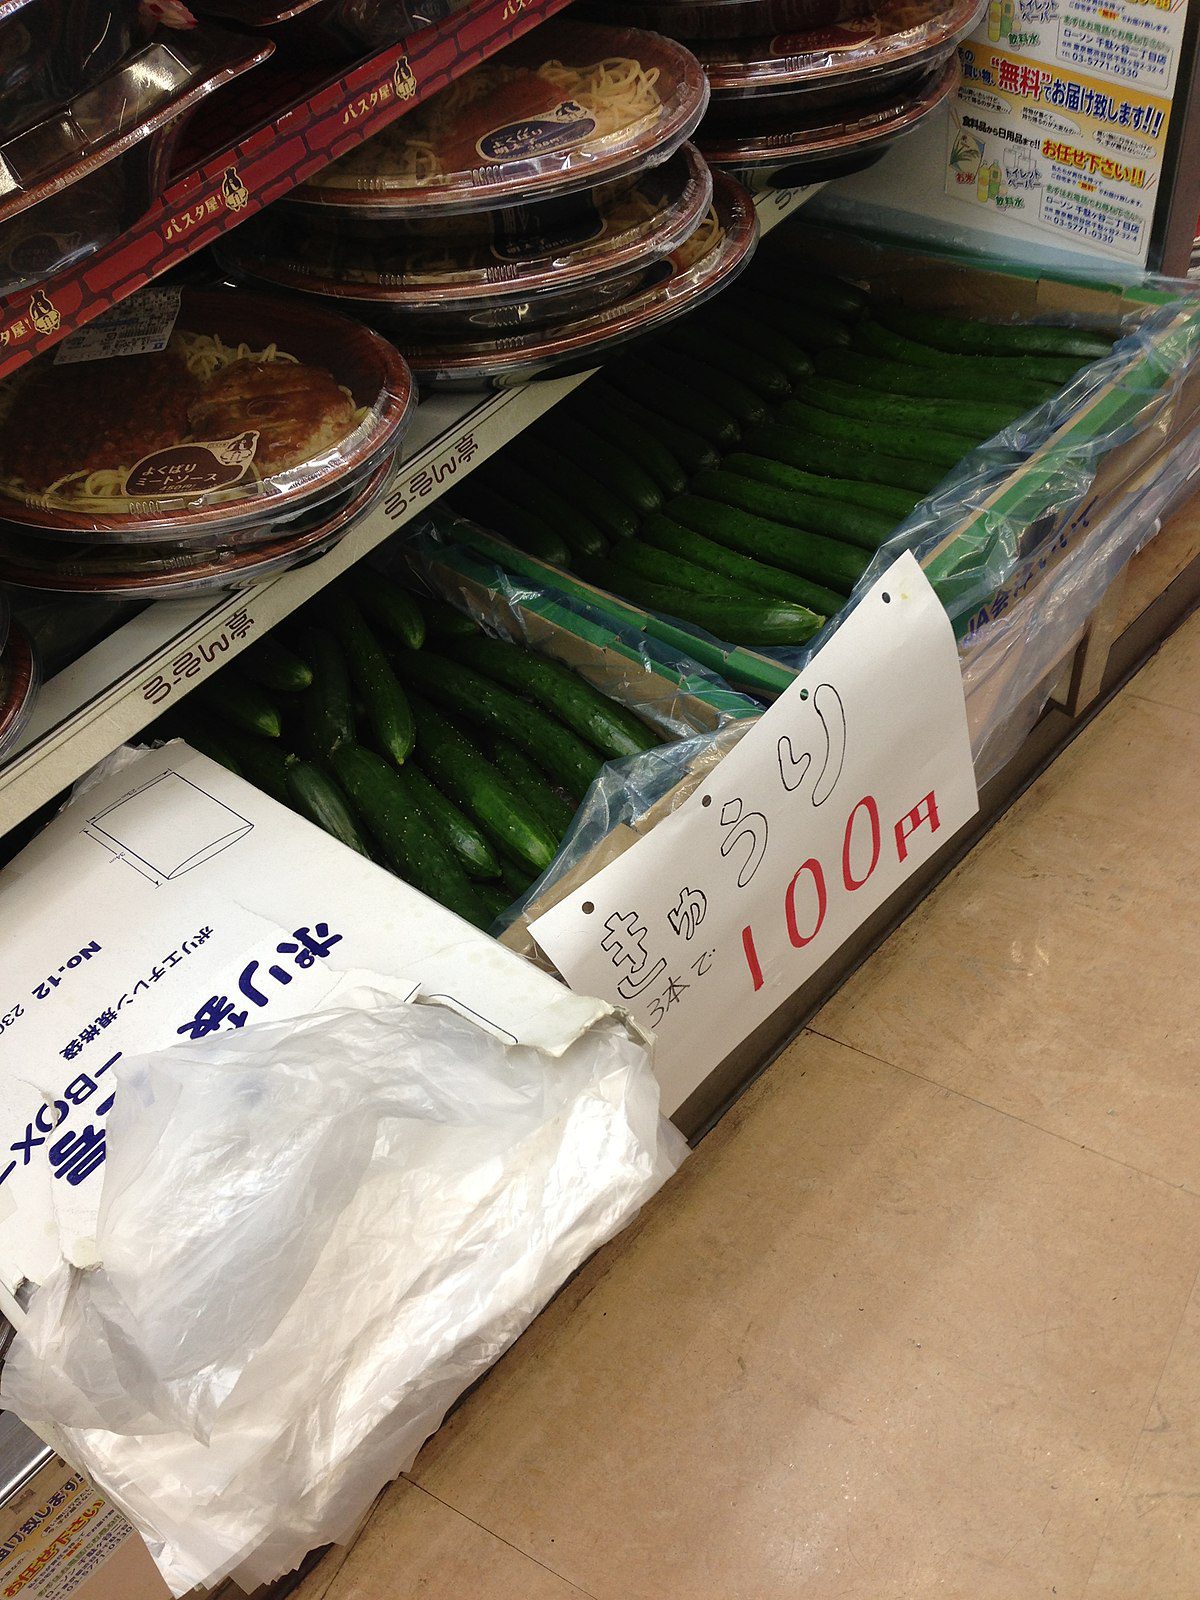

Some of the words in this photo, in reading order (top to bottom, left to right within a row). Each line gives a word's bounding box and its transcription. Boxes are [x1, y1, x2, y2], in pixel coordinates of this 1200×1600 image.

[961, 63, 996, 87] 買い物、
[136, 473, 217, 486] ミートソース
[142, 463, 197, 476] よくばり
[600, 683, 848, 1000] きゅうり
[737, 789, 941, 993] 100円
[31, 940, 103, 1001] No.12
[59, 924, 215, 1061] ポリエチレン規格袋
[646, 947, 716, 1029] 3本で
